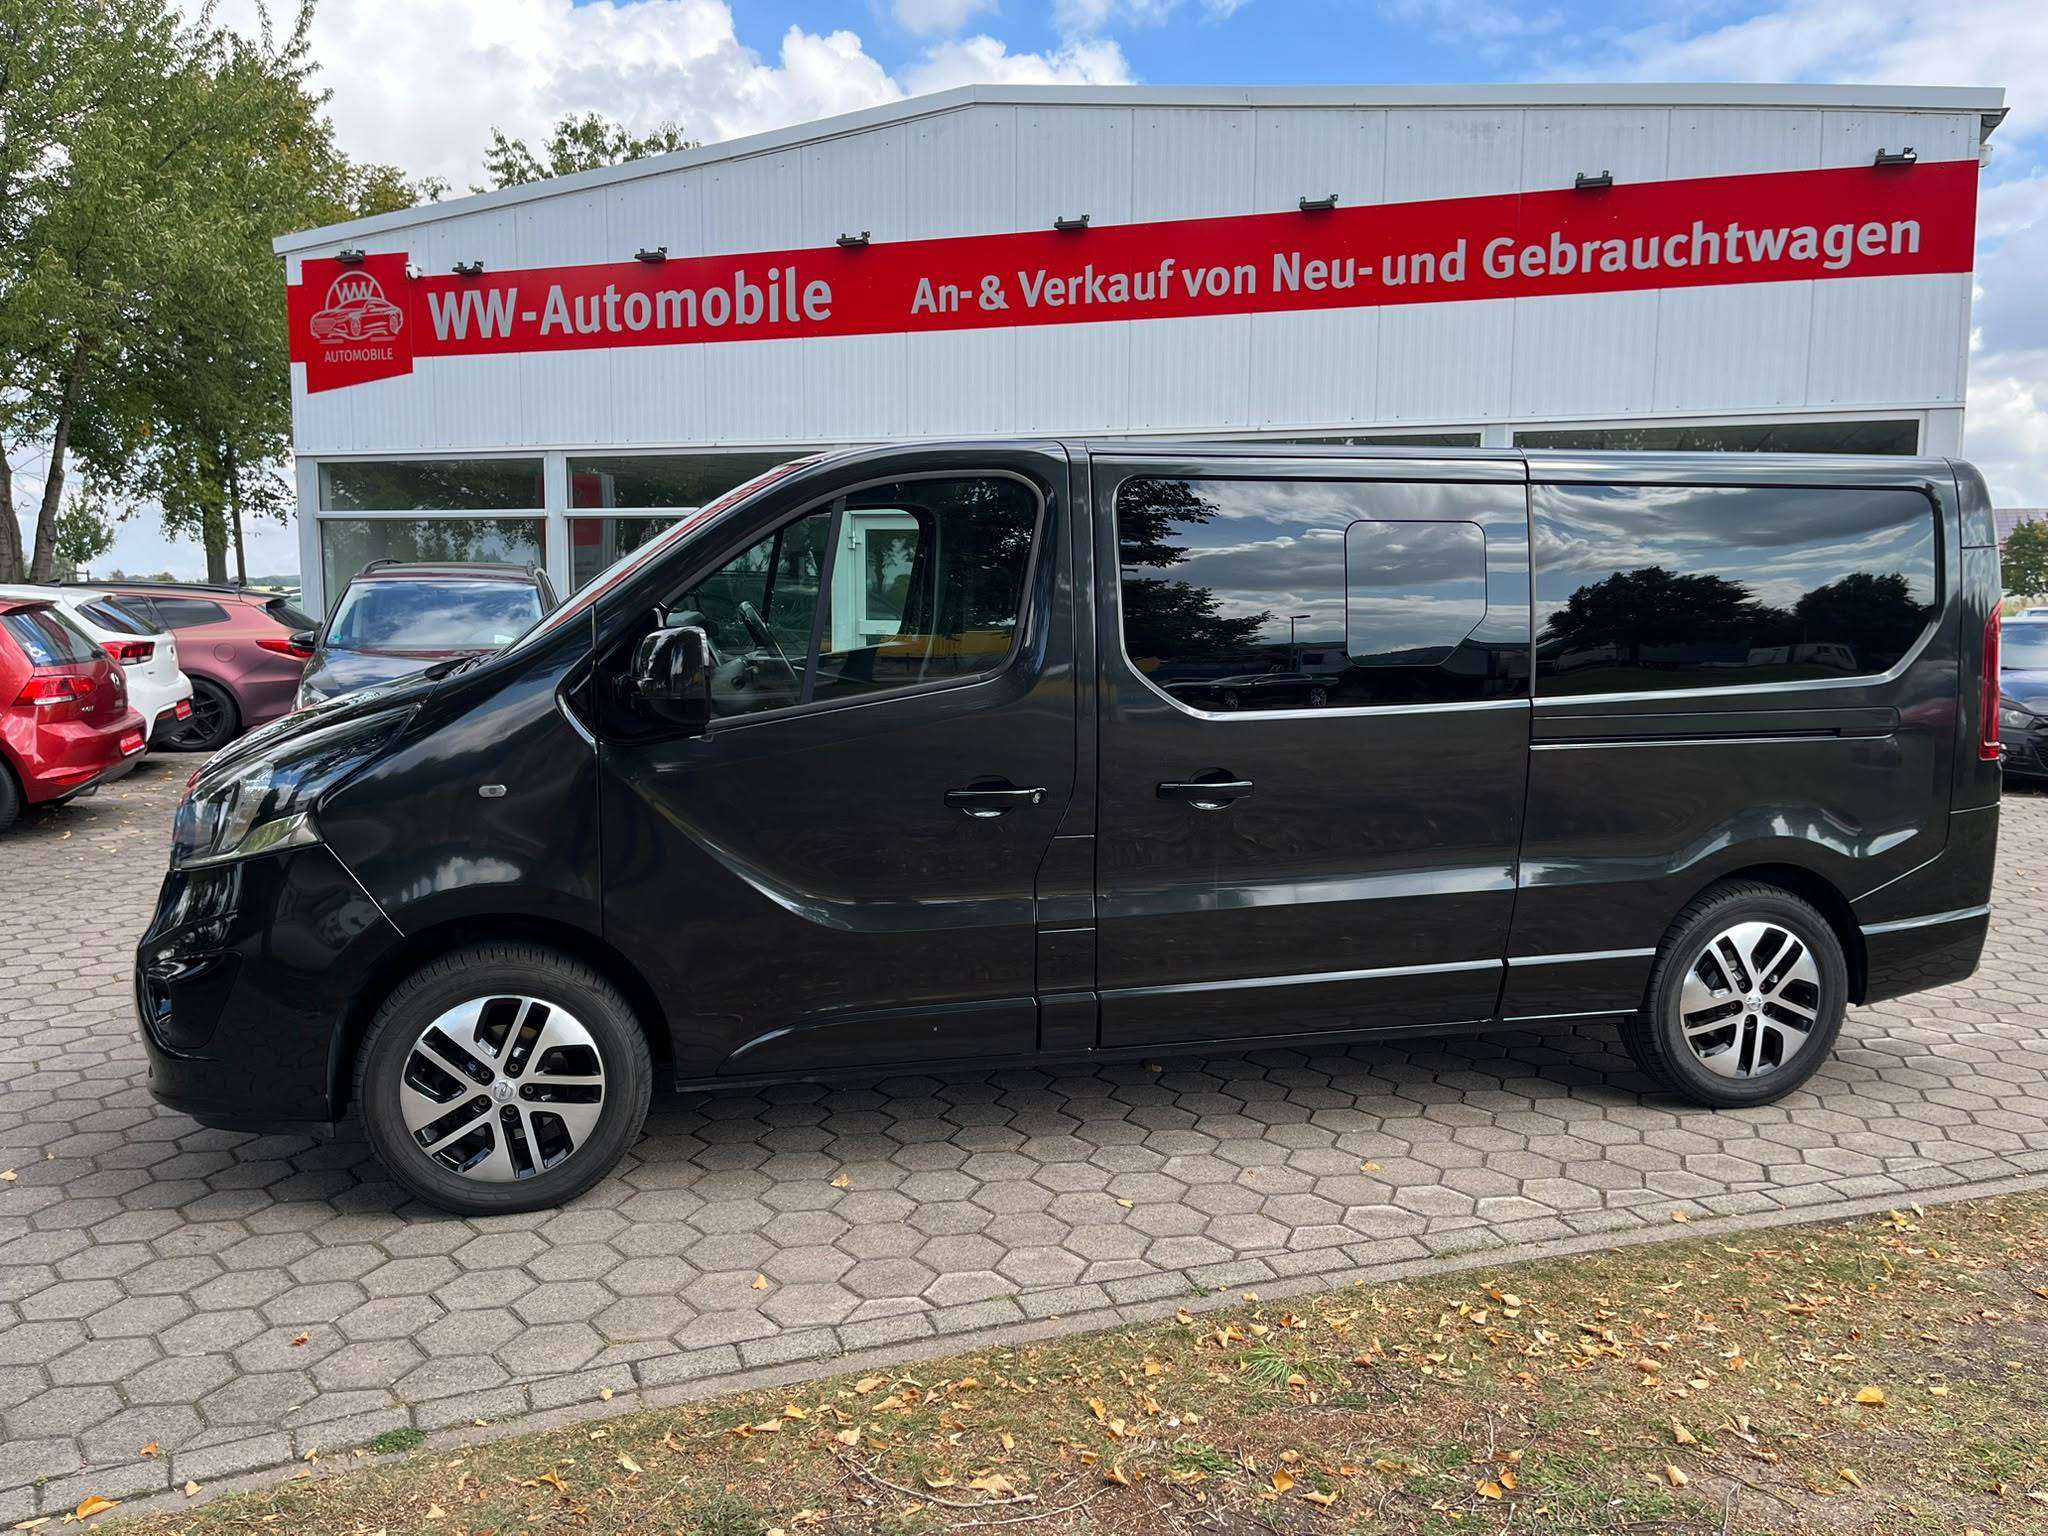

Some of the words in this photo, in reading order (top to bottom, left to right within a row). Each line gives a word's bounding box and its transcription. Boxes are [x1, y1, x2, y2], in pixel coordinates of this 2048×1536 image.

[911, 278, 972, 314] An-
[979, 275, 1009, 310] &
[1018, 259, 1175, 307] Verkauf
[1182, 265, 1256, 297] von
[1273, 252, 1372, 292] Neu-
[1383, 239, 1466, 286] und
[1483, 219, 1921, 280] Gebrauchtwagen
[335, 281, 375, 304] WW
[427, 265, 833, 341] WW-Automobile
[324, 348, 394, 363] AUTOMOBILE
